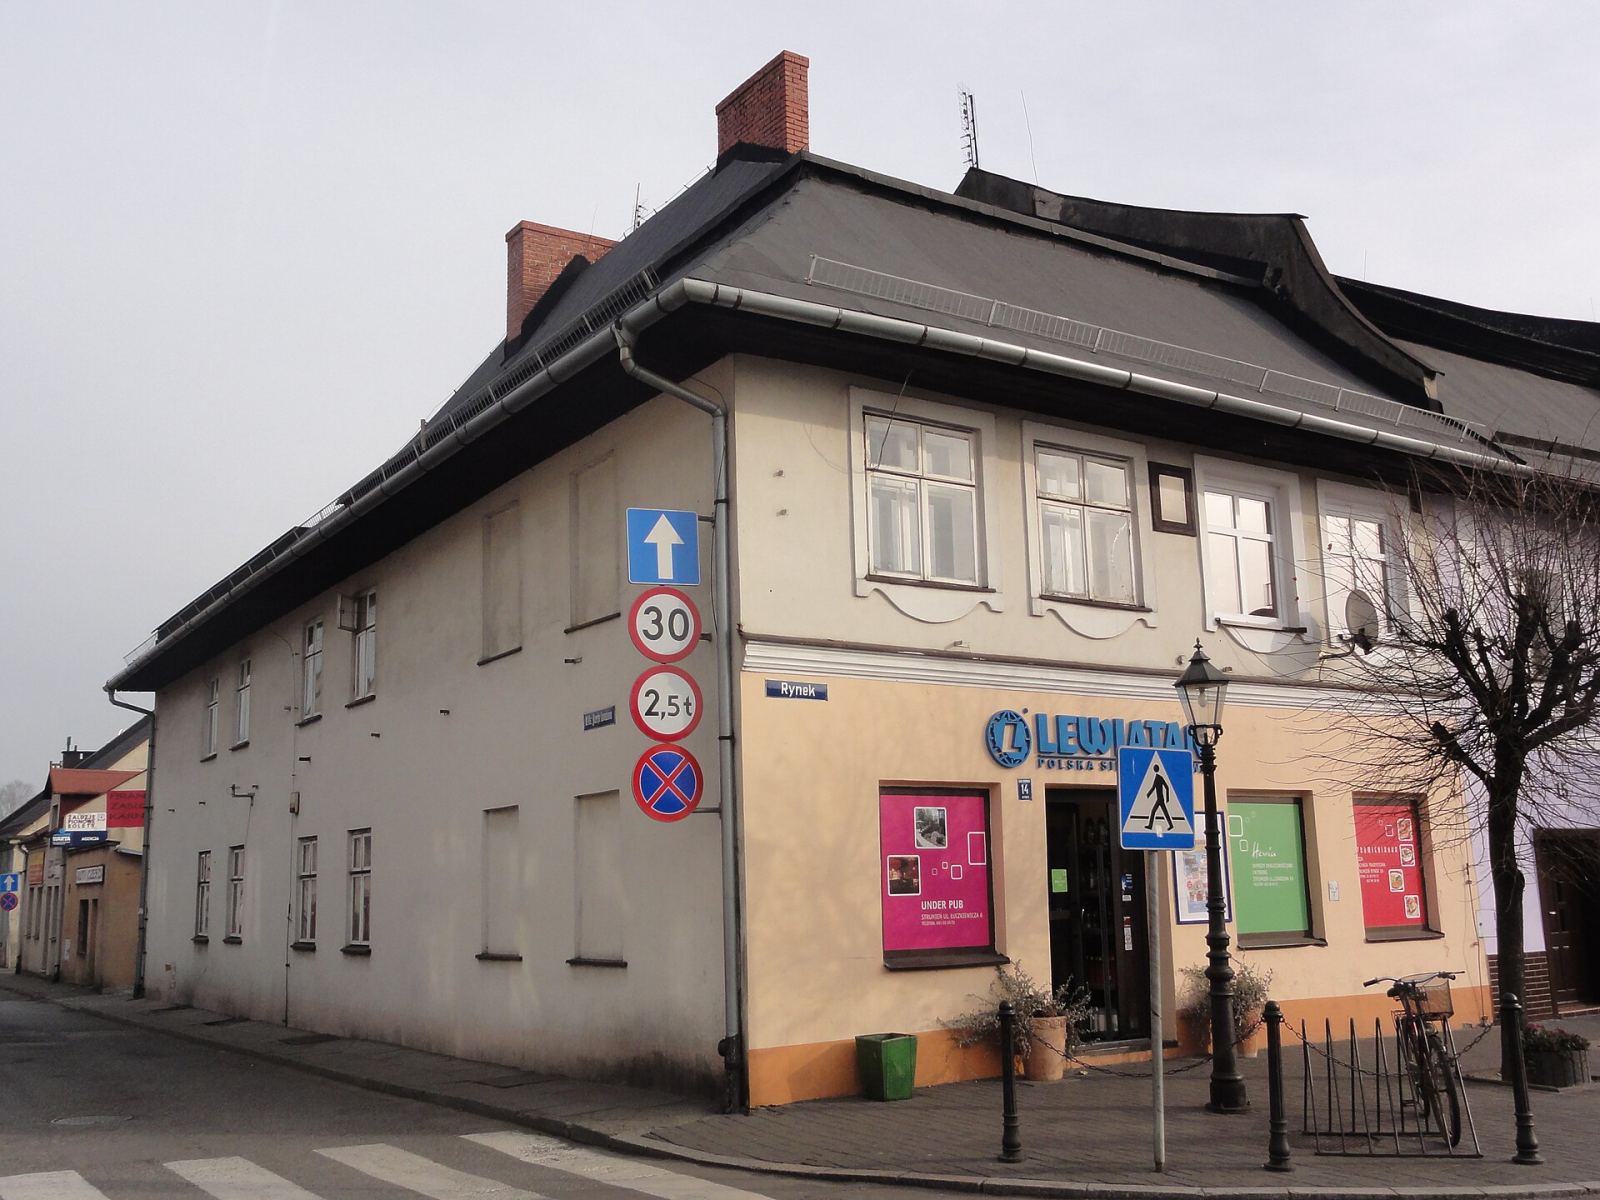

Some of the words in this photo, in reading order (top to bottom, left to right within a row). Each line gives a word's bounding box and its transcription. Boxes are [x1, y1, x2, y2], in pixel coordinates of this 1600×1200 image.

[643, 605, 690, 641] 30
[781, 682, 816, 697] Rynek
[1037, 758, 1094, 771] POLSKA
[1021, 784, 1029, 796] 14
[921, 900, 947, 910] UNDER
[948, 899, 964, 910] PUB
